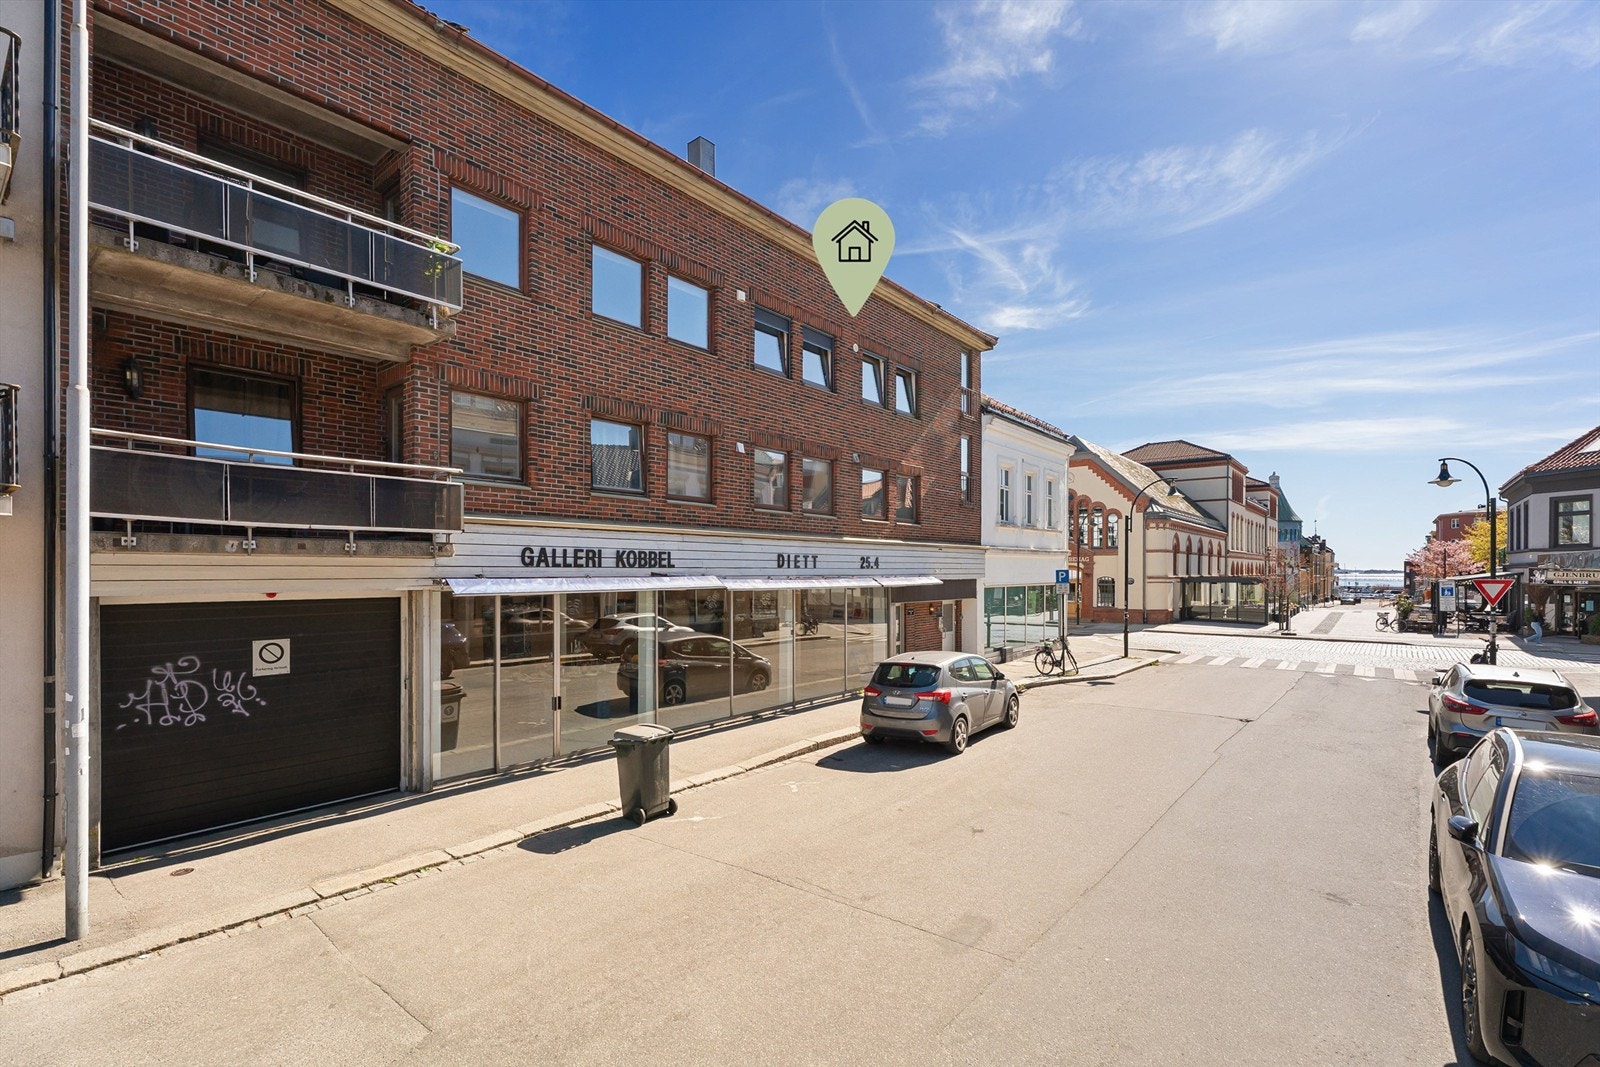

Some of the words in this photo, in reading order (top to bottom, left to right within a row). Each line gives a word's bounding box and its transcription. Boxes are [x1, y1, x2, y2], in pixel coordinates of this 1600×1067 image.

[520, 546, 602, 567] GALLERI
[615, 550, 675, 568] KOBBEL
[777, 553, 818, 569] DIETT
[860, 556, 880, 569] 25.4
[1059, 571, 1067, 582] P
